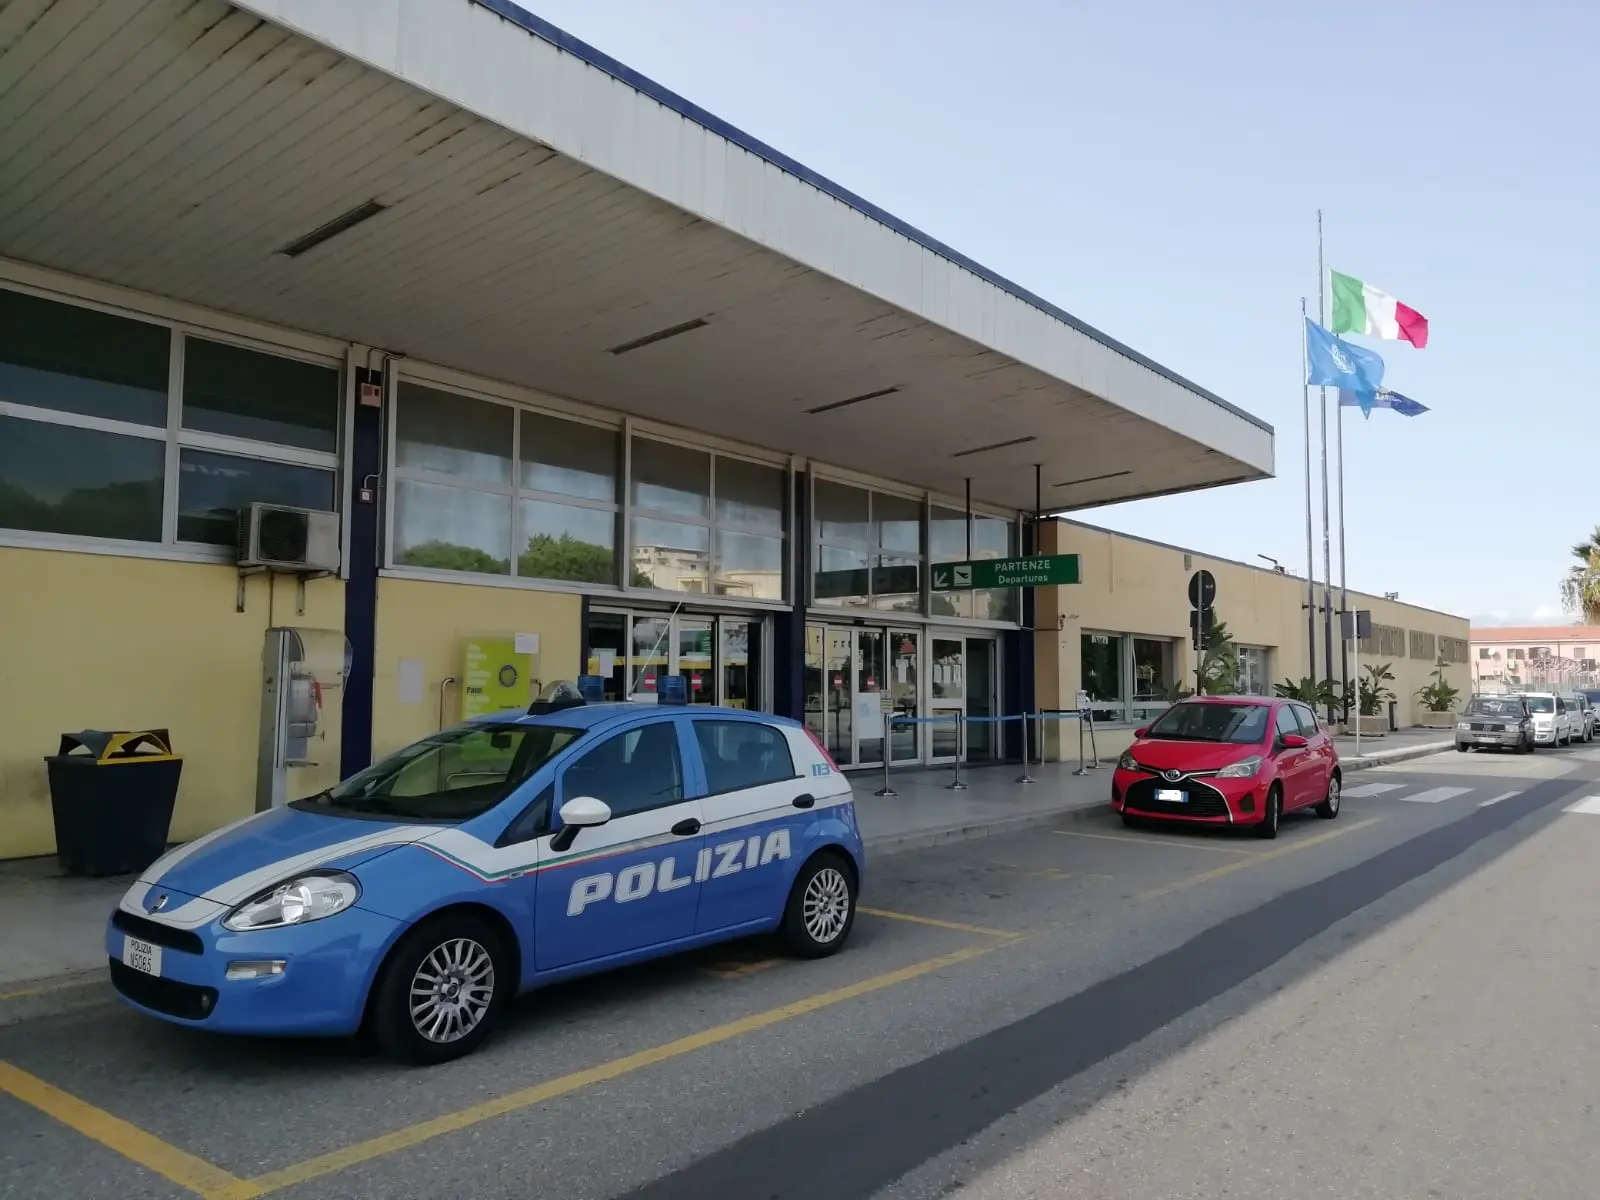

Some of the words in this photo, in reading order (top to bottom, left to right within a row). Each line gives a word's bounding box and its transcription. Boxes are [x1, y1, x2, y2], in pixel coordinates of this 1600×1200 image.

[995, 560, 1051, 572] PARTENZE
[998, 575, 1048, 584] Departures
[811, 763, 831, 777] 113
[566, 828, 791, 916] POLIZIA
[130, 939, 152, 954] POLIZIA
[130, 951, 152, 972] N5065
